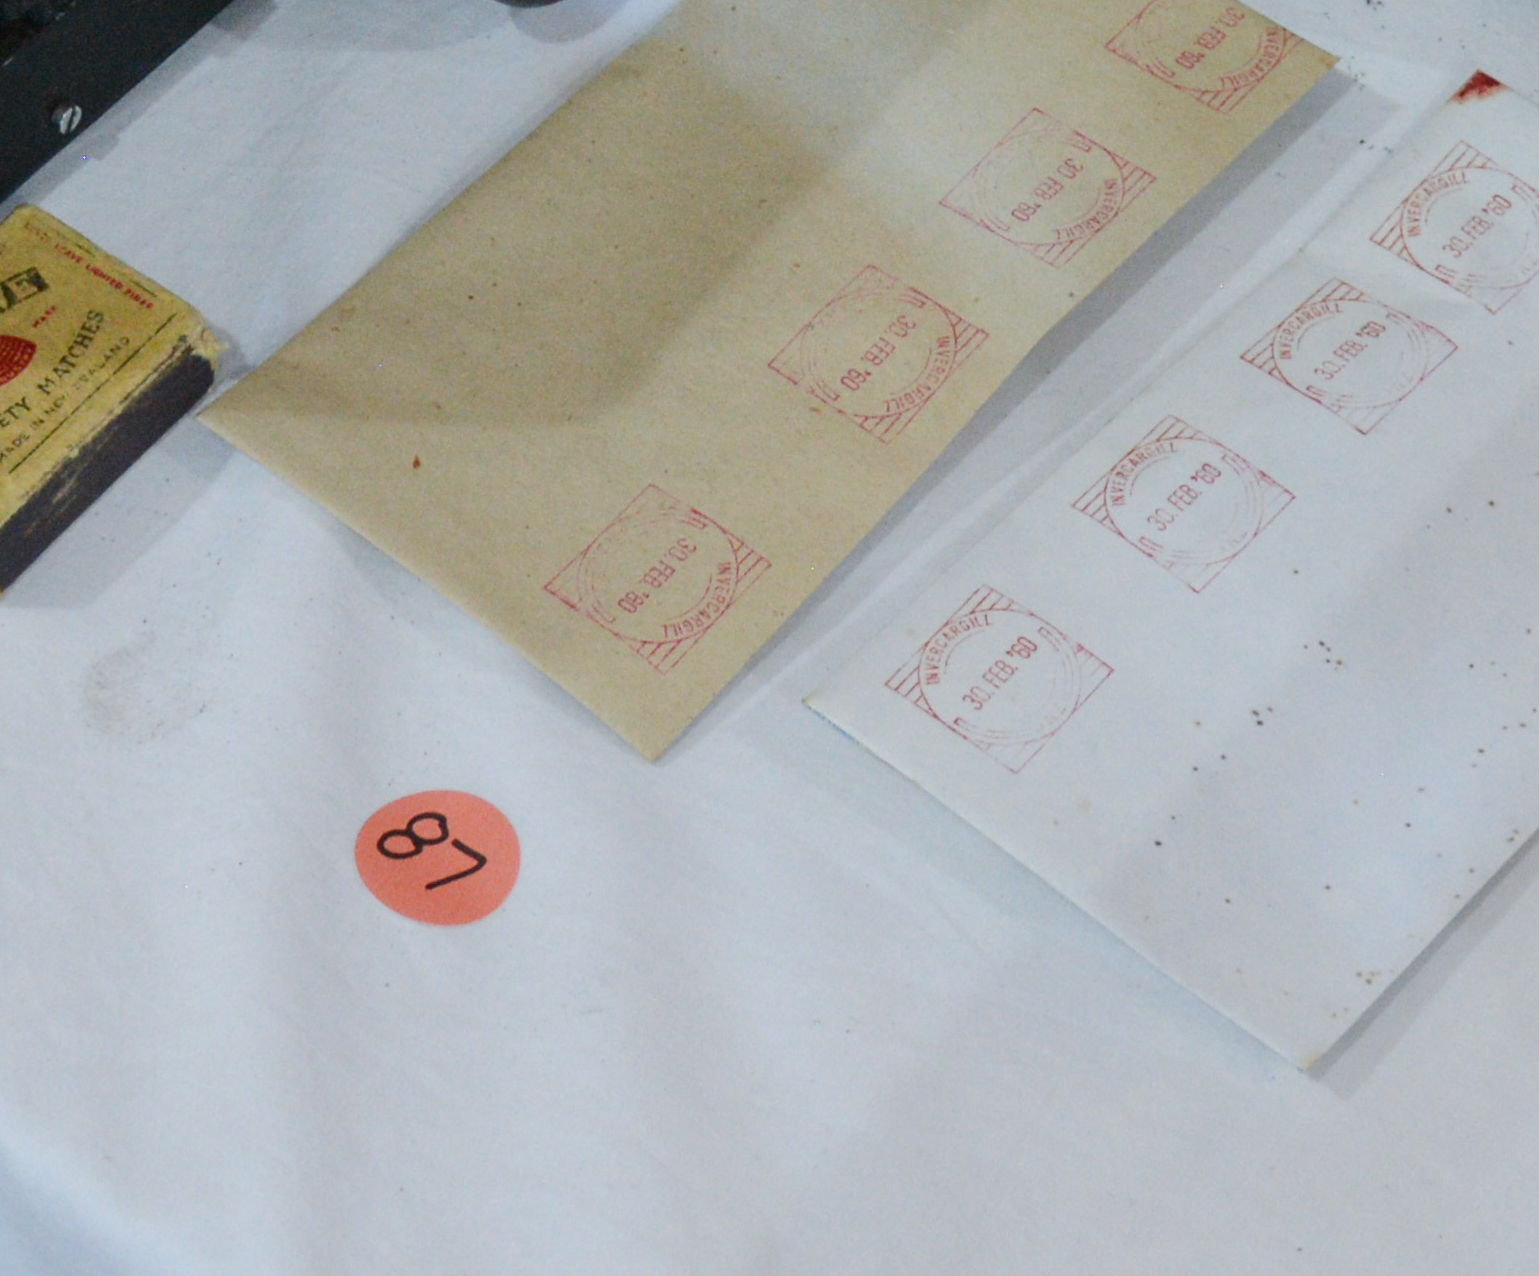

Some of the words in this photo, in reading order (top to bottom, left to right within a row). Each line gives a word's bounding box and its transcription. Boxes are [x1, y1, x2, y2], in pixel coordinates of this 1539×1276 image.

[37, 309, 105, 396] MATCHES
[29, 417, 46, 431] IN
[1110, 440, 1180, 507] INVERCARGILL
[925, 613, 994, 687] INVERCARGILL
[376, 810, 488, 891] 87
